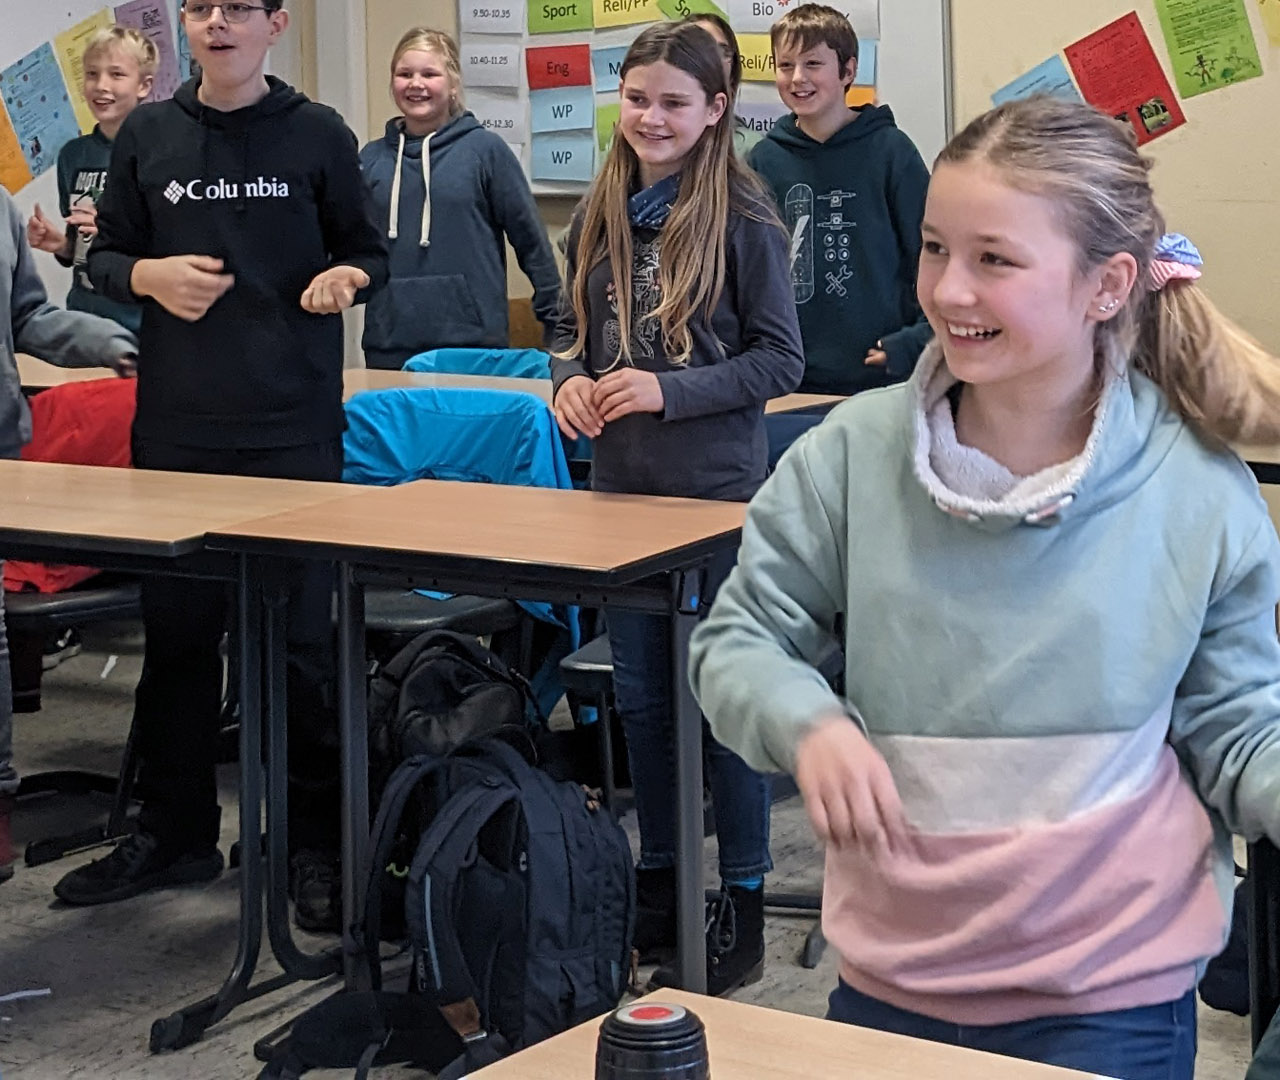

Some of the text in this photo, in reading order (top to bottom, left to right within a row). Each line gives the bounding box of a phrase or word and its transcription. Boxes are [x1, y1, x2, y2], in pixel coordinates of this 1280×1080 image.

[473, 9, 510, 19] 9.50-10.35
[542, 3, 577, 19] Sport
[752, 2, 774, 16] Bio
[546, 61, 569, 77] Eng
[739, 54, 776, 70] Reli/P
[552, 104, 573, 119] WP
[742, 116, 776, 132] Math
[552, 151, 573, 164] WP
